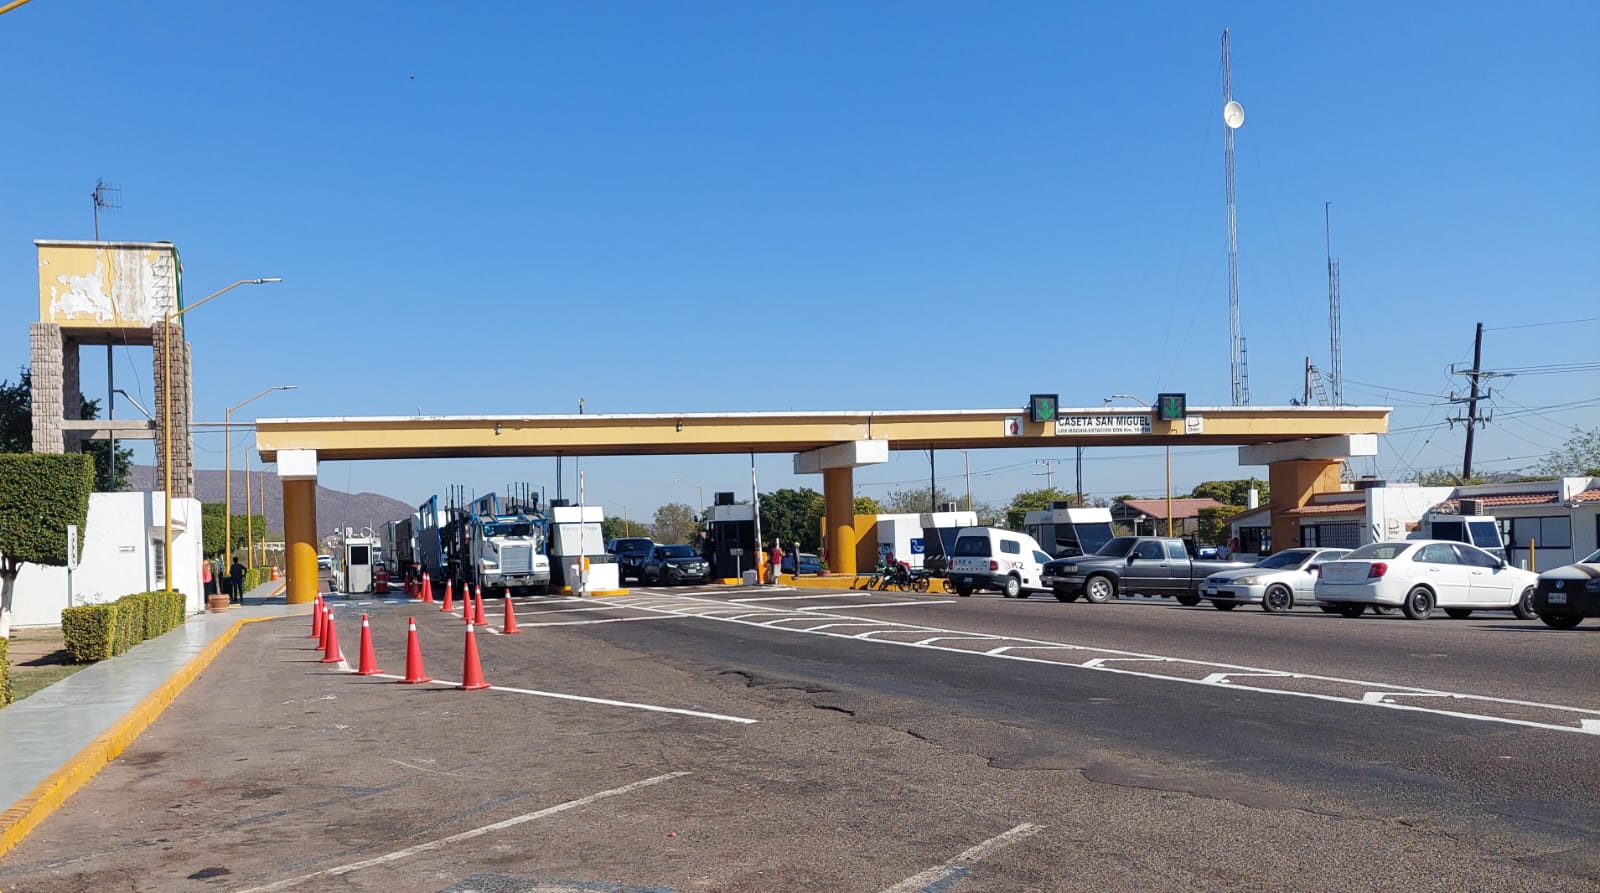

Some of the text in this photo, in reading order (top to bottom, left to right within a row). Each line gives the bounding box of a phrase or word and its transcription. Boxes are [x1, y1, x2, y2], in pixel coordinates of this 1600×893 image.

[1058, 416, 1150, 427] CASETA SAN MIGUEL
